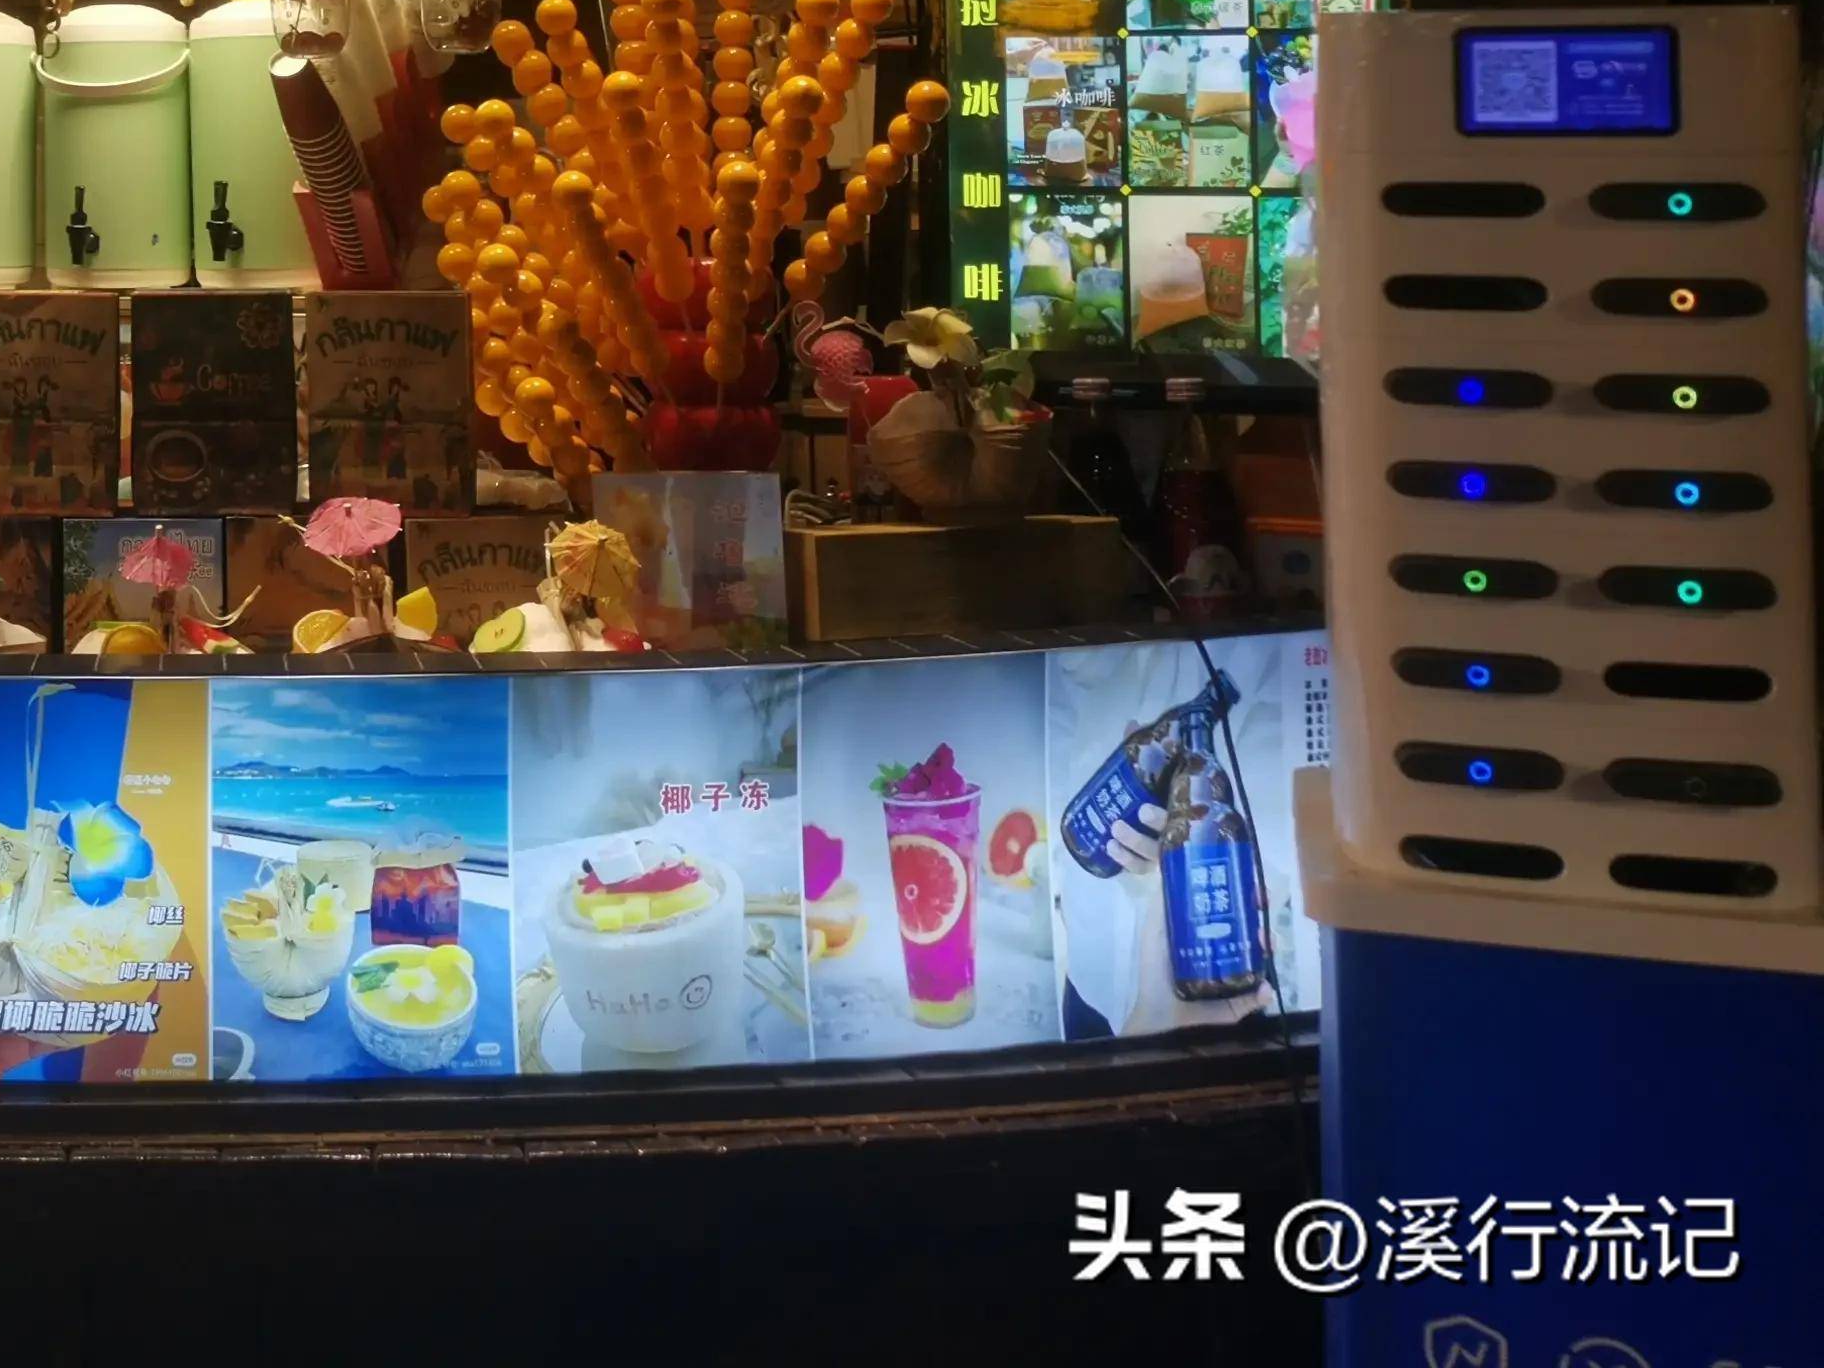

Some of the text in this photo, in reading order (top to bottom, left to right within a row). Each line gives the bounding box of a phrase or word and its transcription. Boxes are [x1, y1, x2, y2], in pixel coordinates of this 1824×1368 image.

[660, 780, 769, 814] 椰子冻
[147, 905, 185, 925] 椰丝
[118, 962, 194, 982] 椰子脆片
